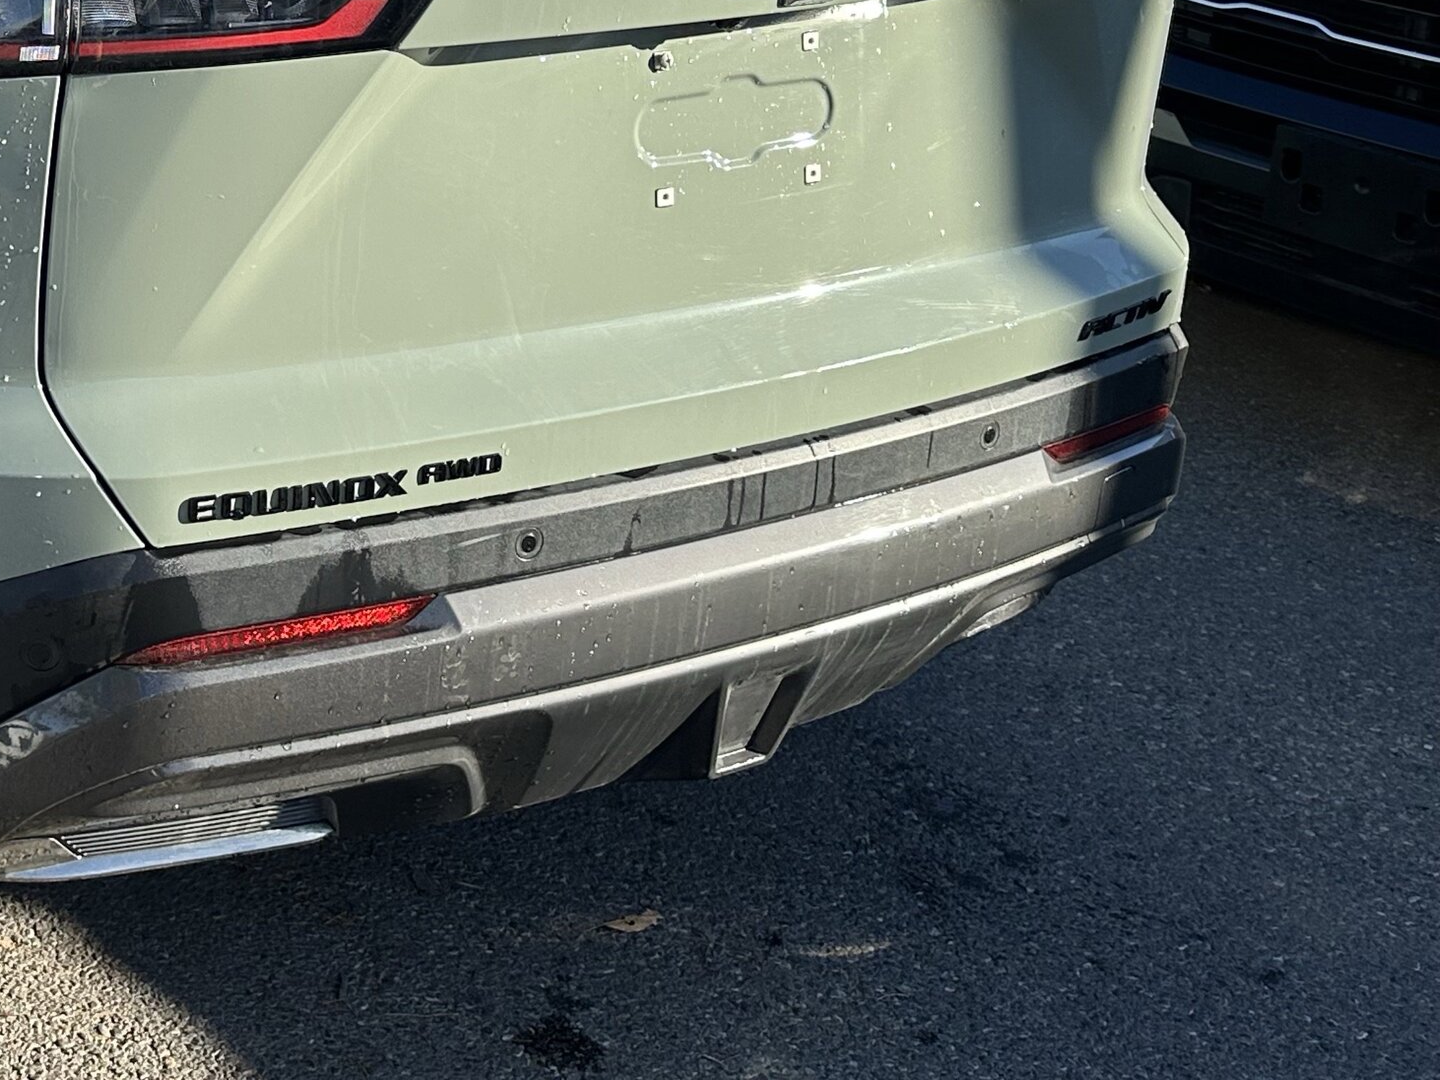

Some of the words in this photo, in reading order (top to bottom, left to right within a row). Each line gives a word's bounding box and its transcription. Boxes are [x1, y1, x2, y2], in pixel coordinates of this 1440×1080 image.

[1076, 288, 1173, 342] ACTIV
[177, 469, 408, 525] EQUINOX
[416, 452, 503, 486] AWD
